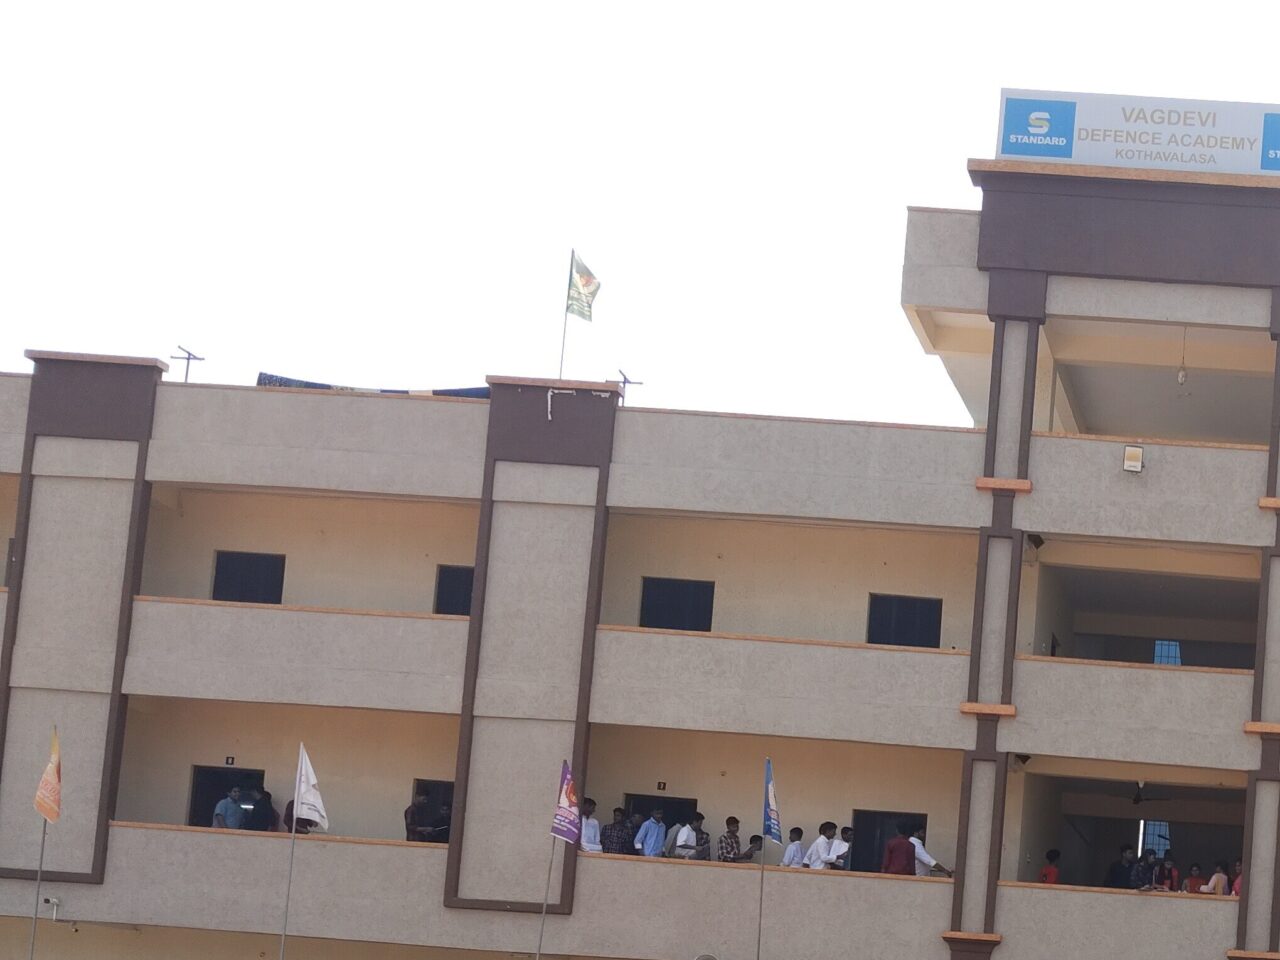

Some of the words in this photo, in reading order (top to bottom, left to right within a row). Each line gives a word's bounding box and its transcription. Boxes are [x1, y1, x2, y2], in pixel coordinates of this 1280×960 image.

[1121, 107, 1217, 128] VAGDEVI
[1009, 134, 1067, 146] STANDARD
[1077, 128, 1162, 146] DEFENCE
[1167, 134, 1258, 151] ACADEMY
[1114, 148, 1217, 165] KOTHAVALASA
